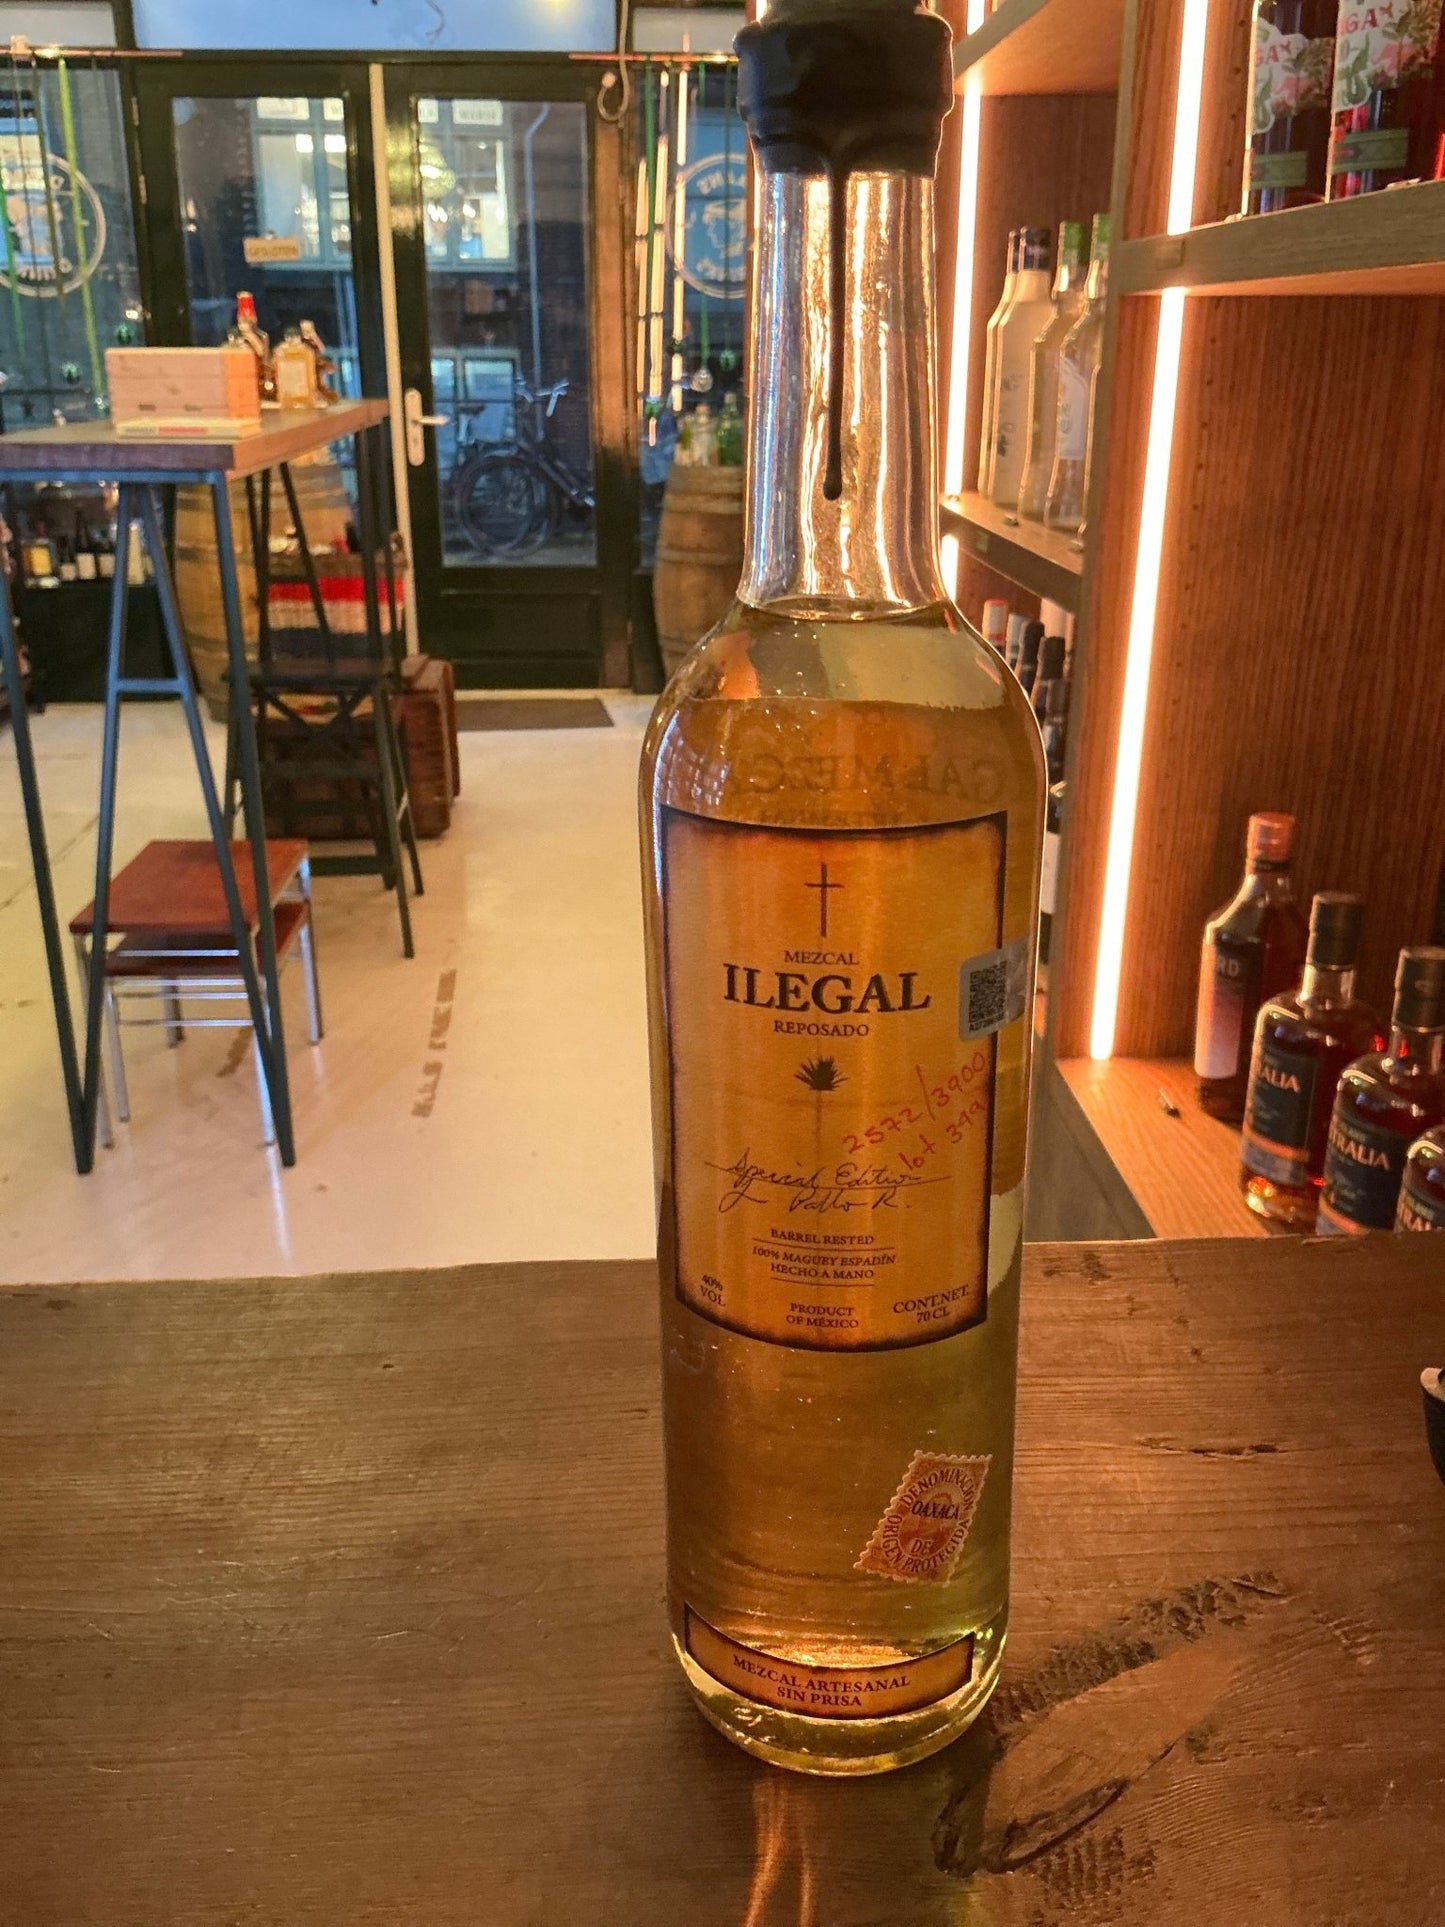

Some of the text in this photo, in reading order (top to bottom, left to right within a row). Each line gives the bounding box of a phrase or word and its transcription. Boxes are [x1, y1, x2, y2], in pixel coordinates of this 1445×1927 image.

[784, 950, 860, 966] MEZCAL
[723, 962, 932, 1015] ILEGAL
[773, 1020, 870, 1037] REPOSADO
[835, 1161, 922, 1187] Edition
[770, 1228, 875, 1246] BARREL RESTED
[751, 1245, 781, 1261] 100%
[781, 1251, 838, 1267] MAGUEY
[770, 1262, 875, 1280] HECHO A MANO
[789, 1302, 856, 1317] PRODUCT
[916, 1306, 951, 1324] 70 CL
[785, 1315, 860, 1329] OF MÉXICO
[911, 1500, 960, 1521] OAXACA
[902, 1519, 969, 1573] PROTEGIDA
[911, 1539, 932, 1556] DE
[733, 1655, 910, 1693] MEZCAL ARTESANAL
[777, 1686, 862, 1706] SIN PRISA
